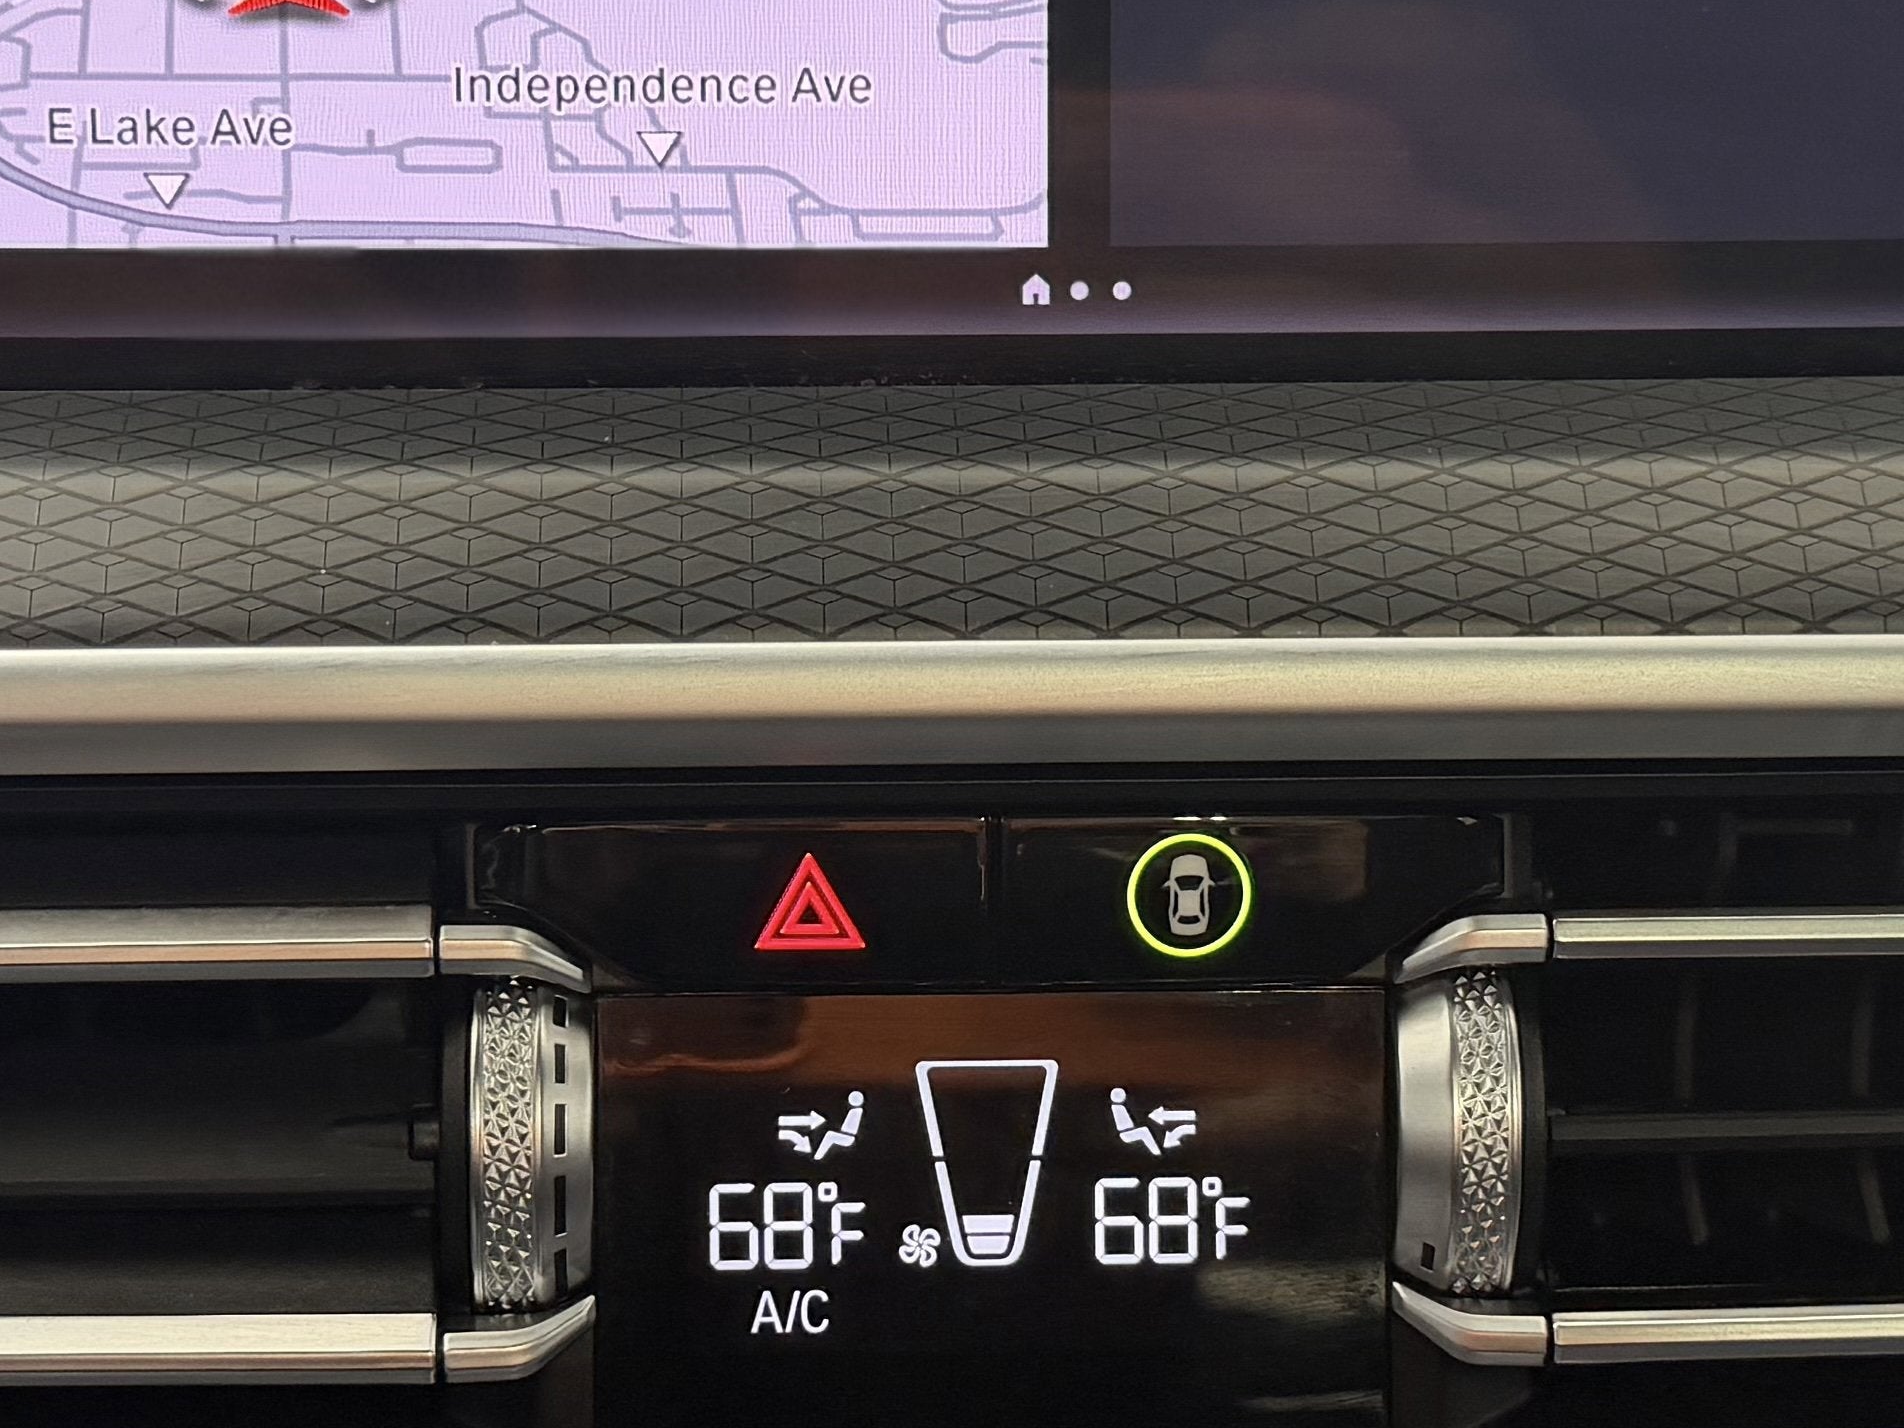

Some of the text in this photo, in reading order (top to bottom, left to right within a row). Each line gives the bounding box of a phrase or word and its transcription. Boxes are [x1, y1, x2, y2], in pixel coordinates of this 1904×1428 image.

[453, 67, 873, 112] Independence Ave
[48, 110, 293, 146] E Lake Ave
[751, 1289, 830, 1333] A/C
